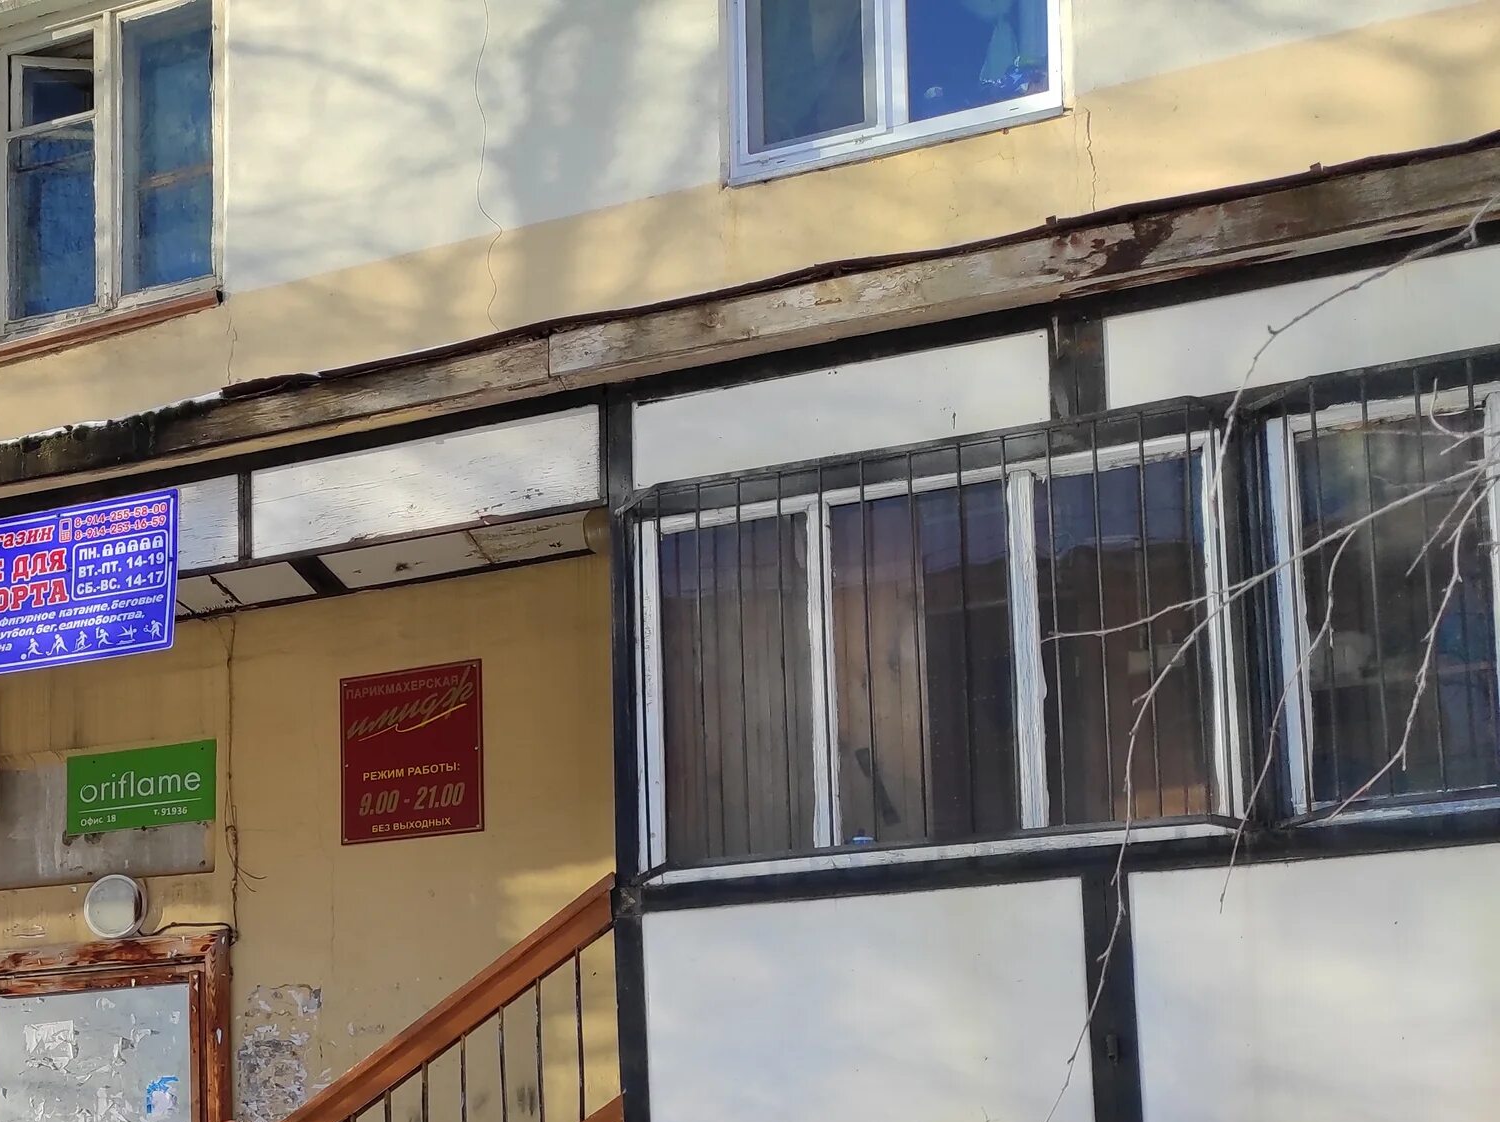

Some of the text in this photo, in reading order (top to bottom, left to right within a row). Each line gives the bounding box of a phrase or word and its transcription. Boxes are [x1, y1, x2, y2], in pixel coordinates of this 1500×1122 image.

[74, 503, 167, 528] 8-914-255-58-00
[74, 516, 166, 540] 8-914-253-16-59
[79, 547, 100, 561] ПН.
[126, 552, 164, 569] 14-19
[12, 548, 67, 583] ДЛЯ
[126, 571, 164, 588] 14-17
[346, 675, 459, 700] ПАРИКМАХЕРСКАЯ
[363, 762, 461, 782] РЕЖИМ РАБОТЫ:
[80, 770, 201, 803] oriflame
[359, 789, 400, 816] 9.00
[414, 782, 466, 811] 21.00
[80, 816, 103, 827] Офис
[107, 815, 116, 823] 18
[372, 817, 452, 833] БЕЗ ВЫХОДНЫХ
